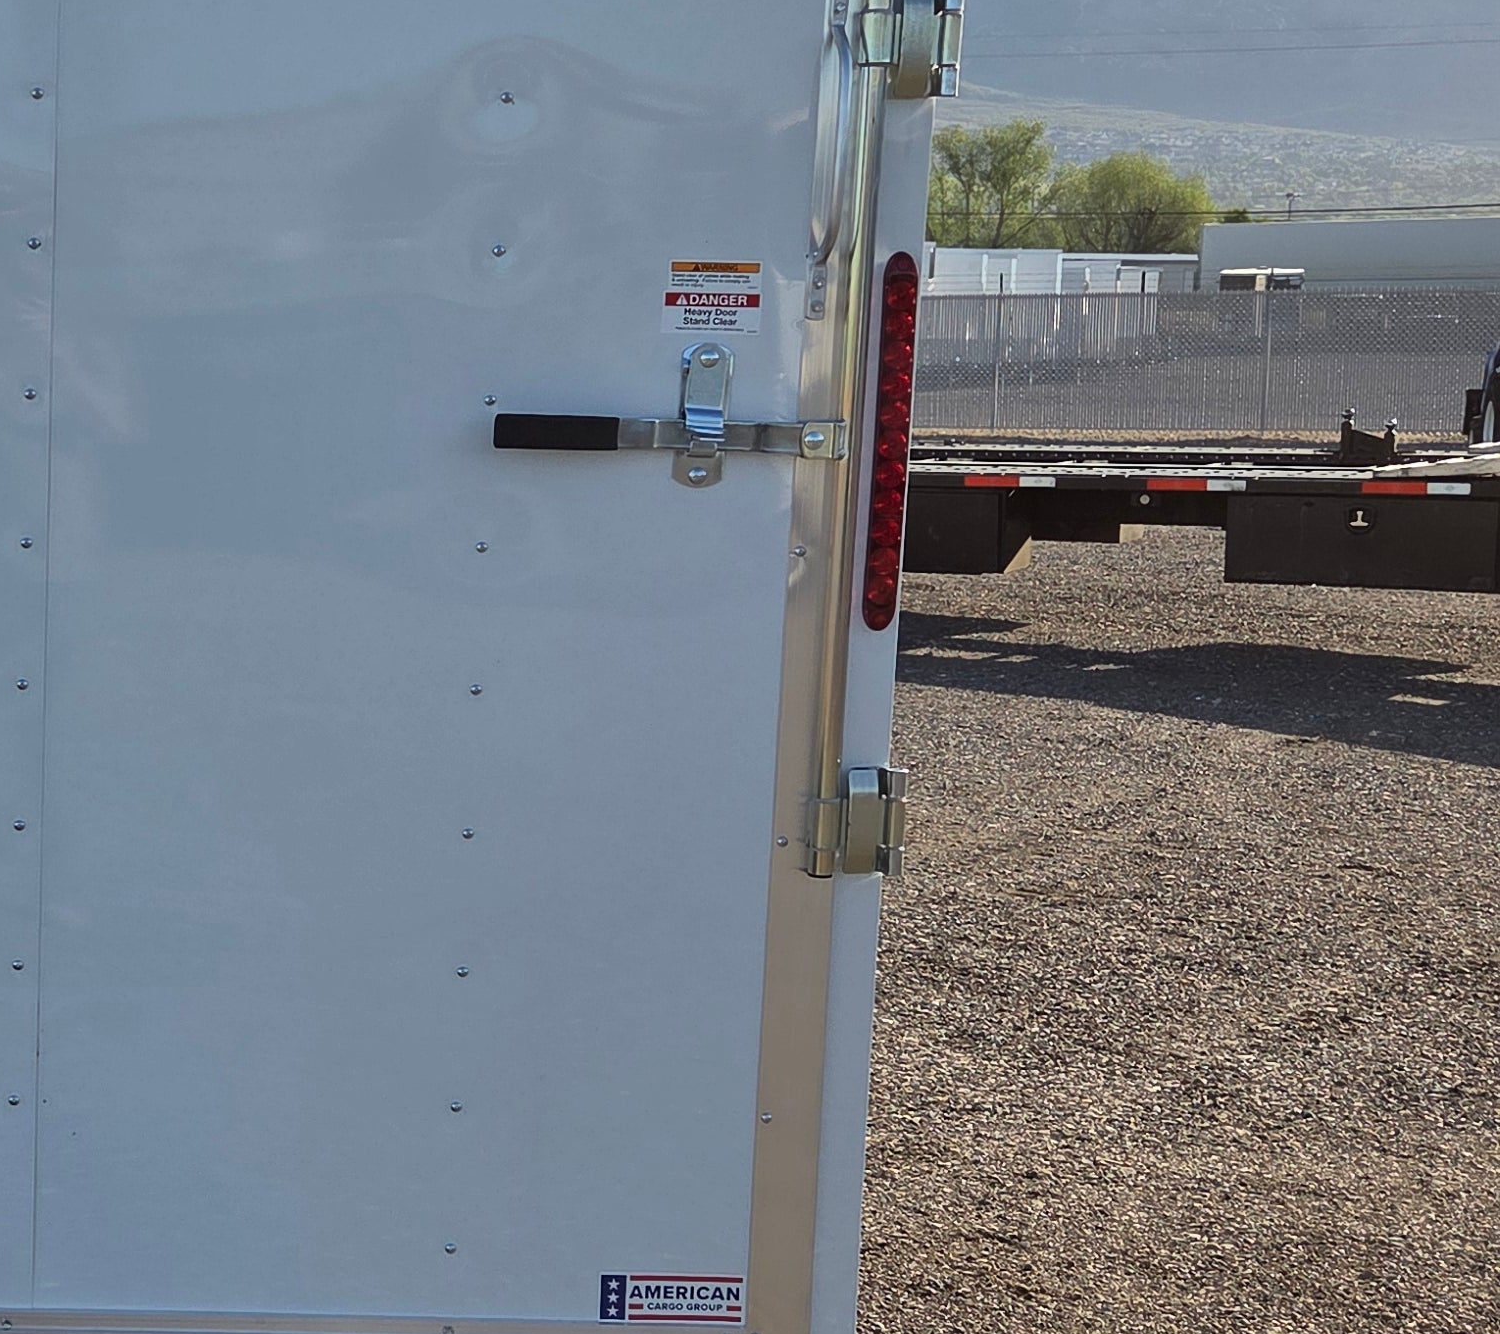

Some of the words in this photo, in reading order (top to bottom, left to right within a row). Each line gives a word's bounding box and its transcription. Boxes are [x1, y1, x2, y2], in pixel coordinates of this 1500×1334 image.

[689, 294, 748, 306] DANGER
[684, 308, 713, 317] Heavy
[683, 317, 710, 325] Stand
[712, 317, 738, 326] Clear
[629, 1285, 740, 1301] AMERICAN
[647, 1302, 684, 1311] CARGO
[686, 1303, 723, 1312] GROUP
